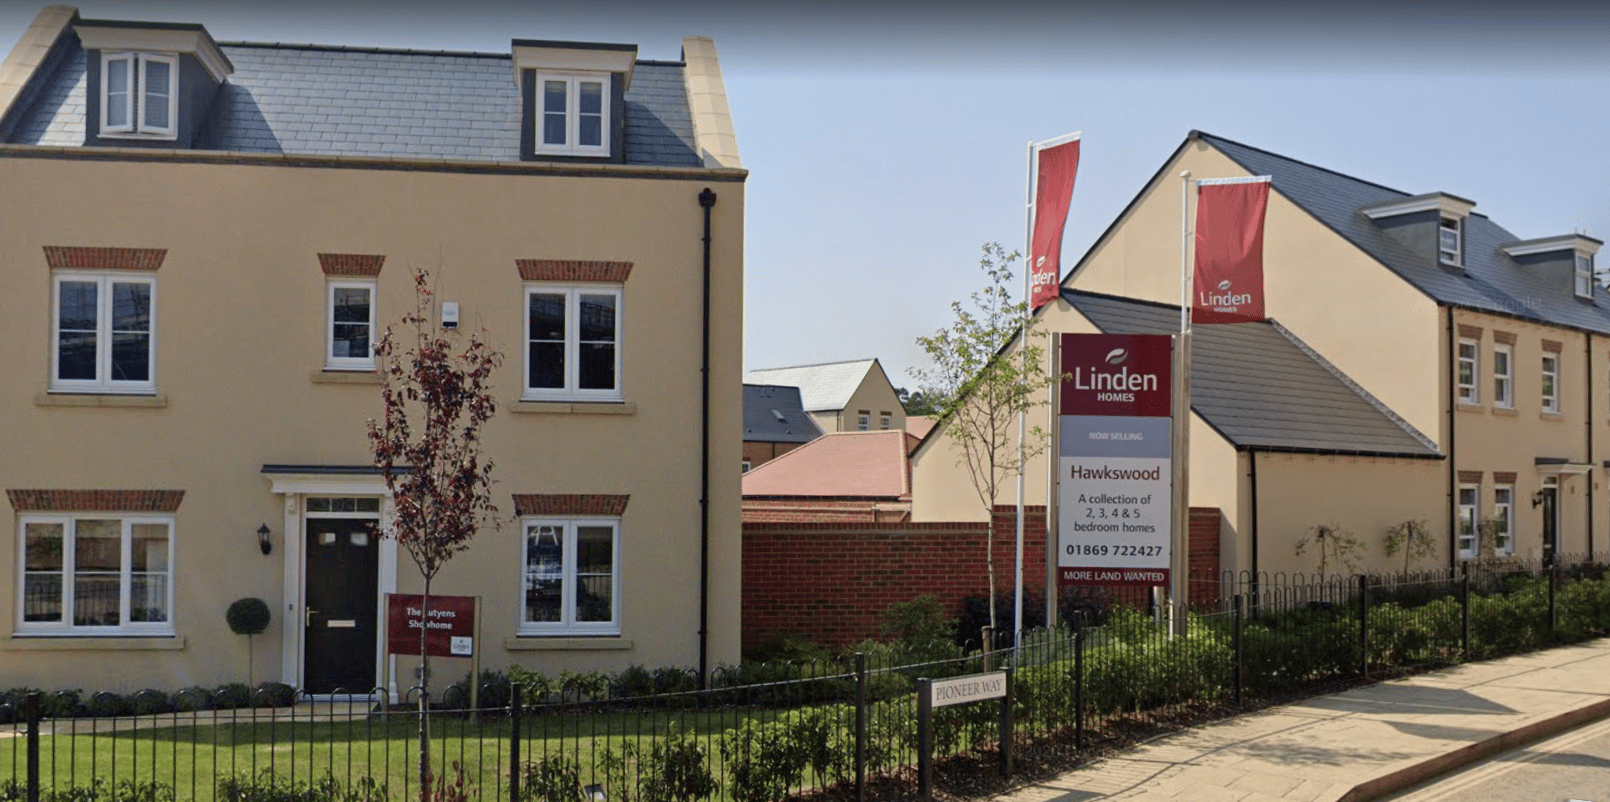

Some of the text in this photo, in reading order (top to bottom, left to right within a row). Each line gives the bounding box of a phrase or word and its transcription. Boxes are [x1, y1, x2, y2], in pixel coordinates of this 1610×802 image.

[1200, 290, 1252, 306] Linden
[1075, 366, 1158, 391] Linden
[1097, 392, 1135, 402] HOMES
[1089, 432, 1144, 441] NOW SELLING
[1071, 465, 1160, 480] Hawkswood
[1078, 493, 1152, 505] A collection of
[1086, 507, 1141, 519] 2, 3, 4 & 5
[1074, 521, 1156, 533] bedroom homes
[1066, 545, 1163, 556] 01869 722427
[1063, 571, 1165, 582] MORE LAND WANTED
[406, 607, 456, 619] The utyens
[936, 678, 1003, 700] PIONEER WAY
